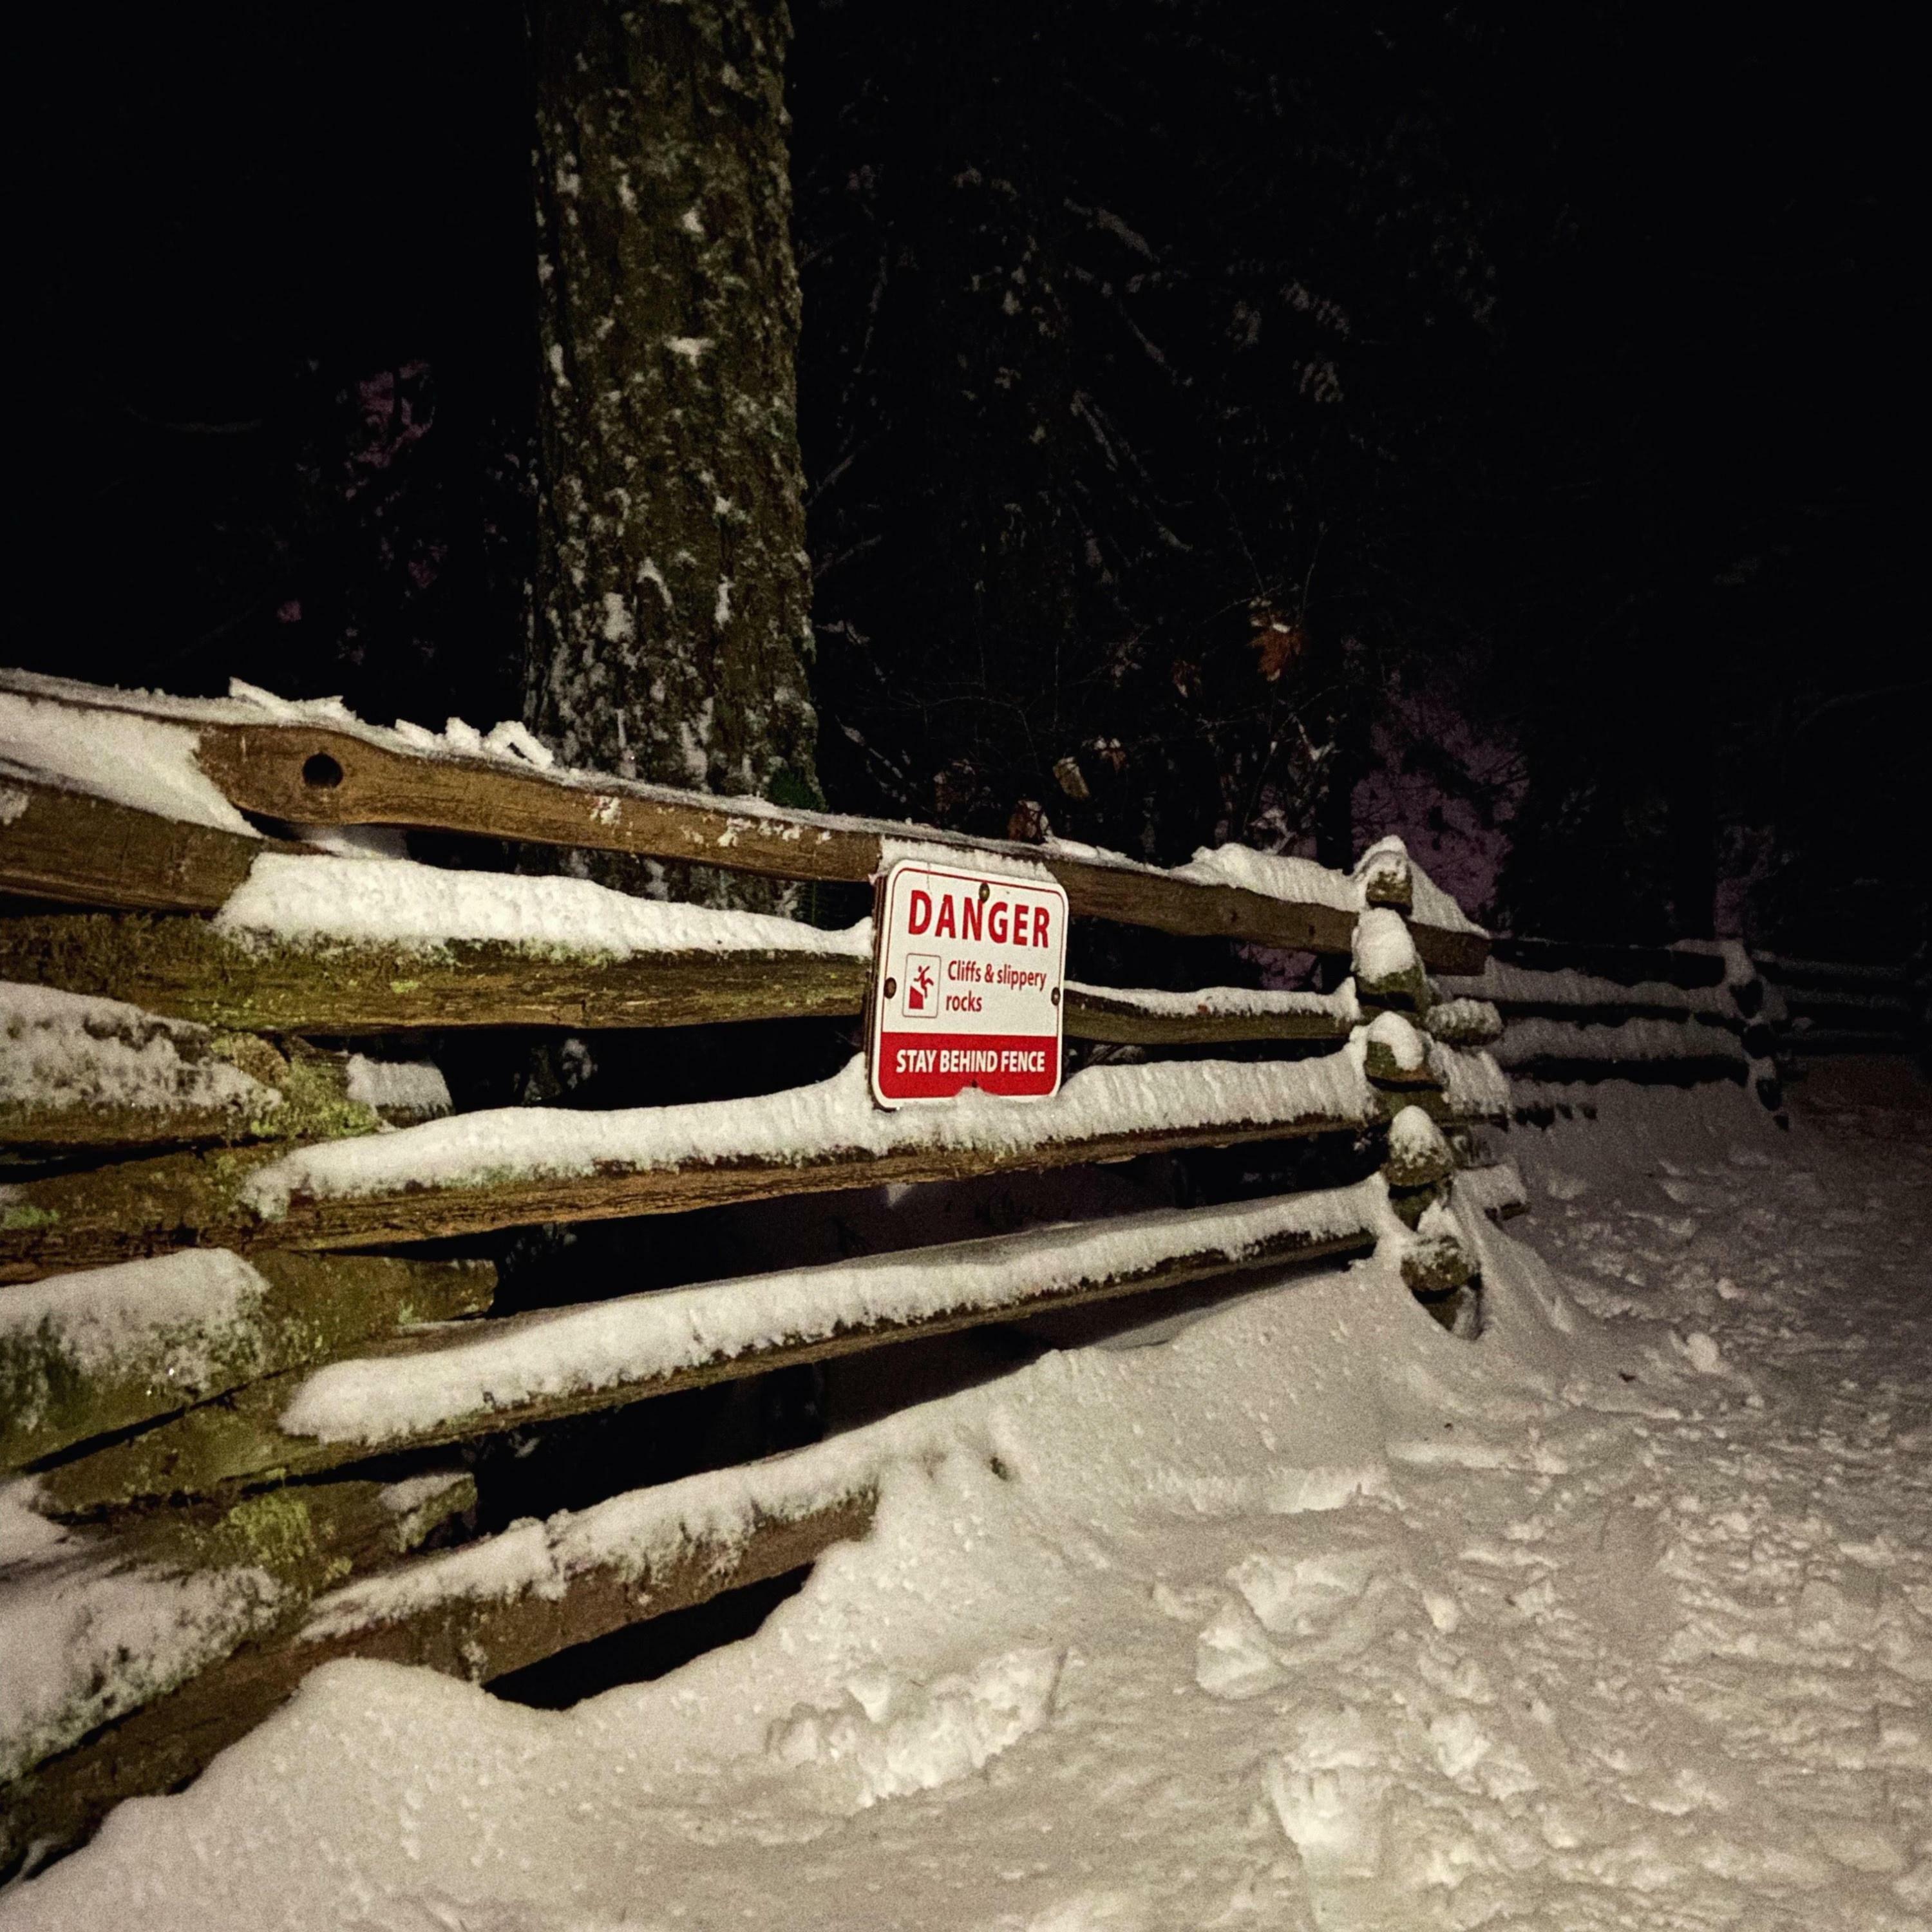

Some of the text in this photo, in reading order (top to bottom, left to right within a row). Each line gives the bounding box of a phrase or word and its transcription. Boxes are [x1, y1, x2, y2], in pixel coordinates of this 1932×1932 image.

[908, 889, 1050, 948] DANGER
[948, 960, 1046, 991] Cliffs & slippery
[945, 990, 982, 1012] rocks
[896, 1050, 1045, 1073] STAY BEHIND FENCE
